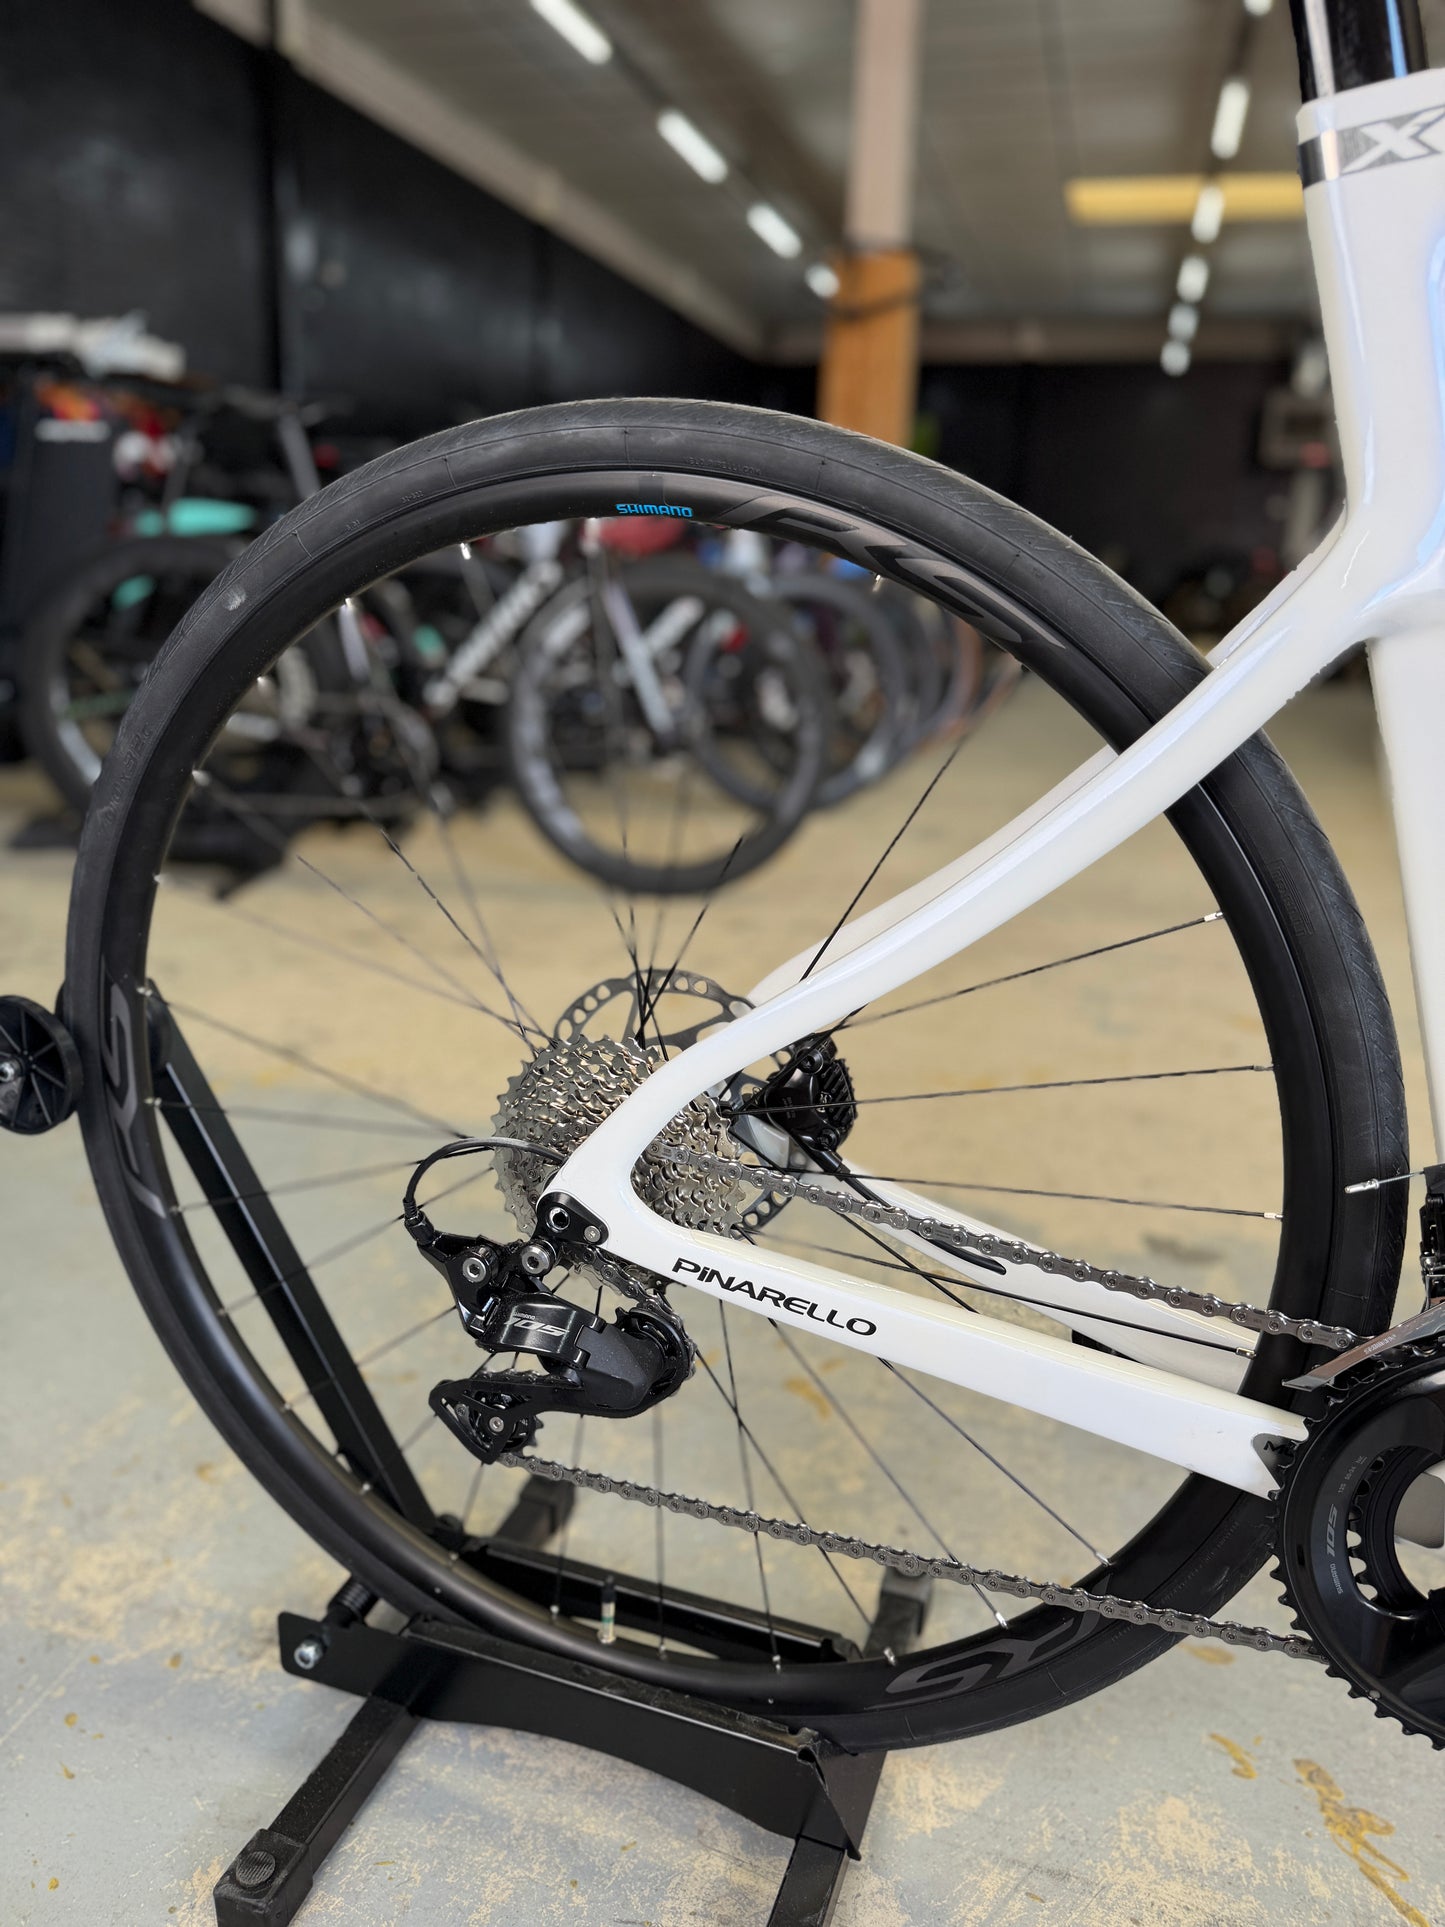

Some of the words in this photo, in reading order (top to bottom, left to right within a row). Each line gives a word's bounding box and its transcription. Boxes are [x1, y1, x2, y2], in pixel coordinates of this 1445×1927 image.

[616, 503, 693, 518] SHIMANO
[504, 1318, 570, 1337] 105
[1326, 1503, 1338, 1557] 105
